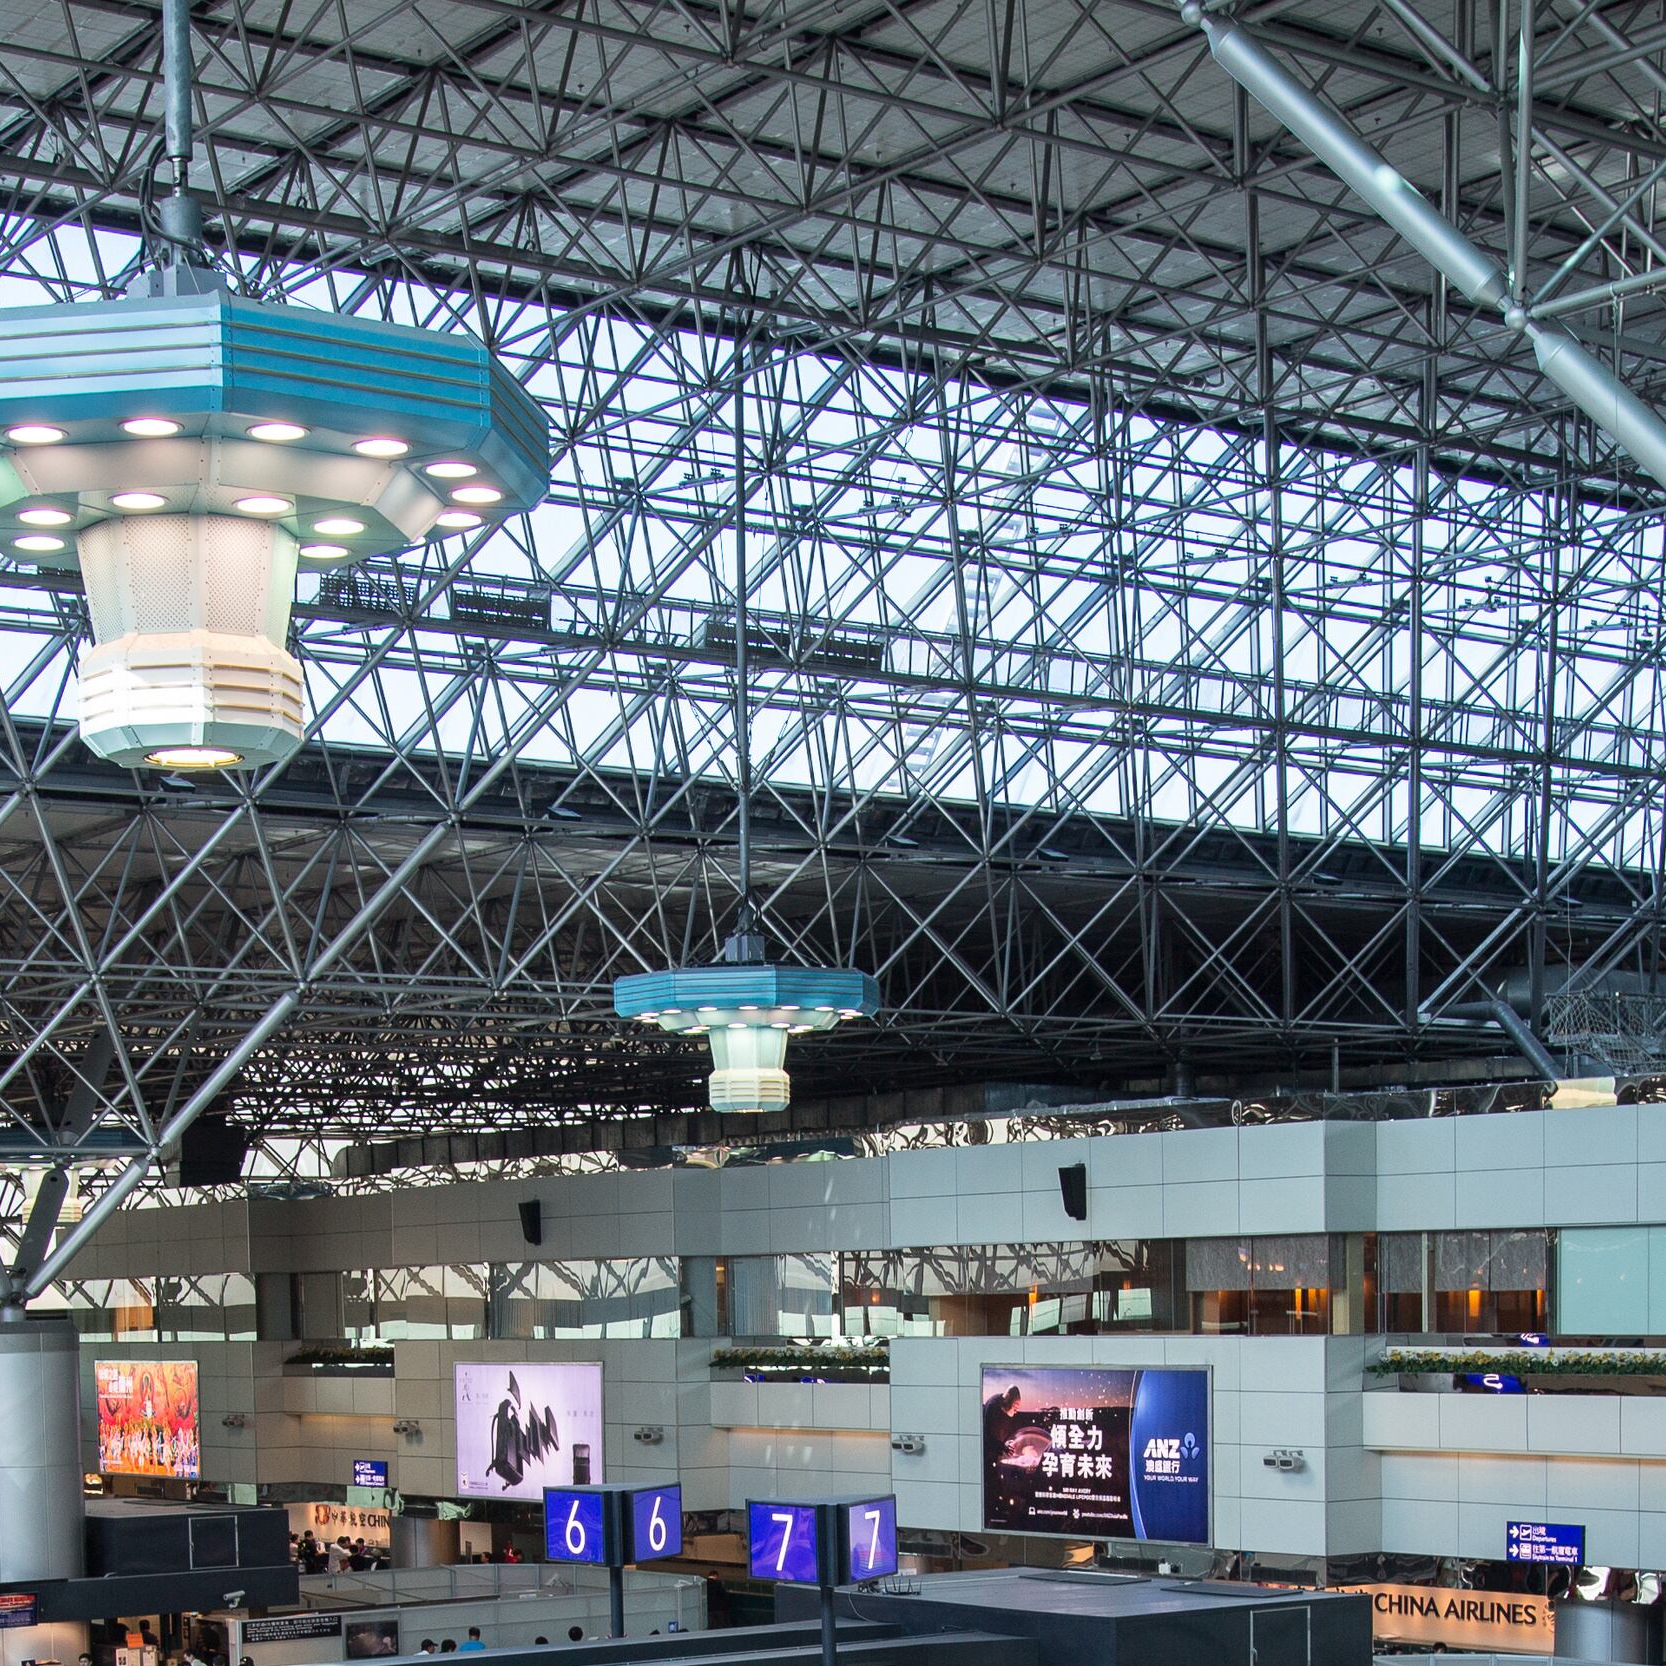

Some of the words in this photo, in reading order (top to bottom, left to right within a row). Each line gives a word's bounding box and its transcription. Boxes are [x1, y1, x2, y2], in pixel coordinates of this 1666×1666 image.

[1060, 1407, 1094, 1421] 推動創新
[1050, 1424, 1103, 1451] 傾全力
[1144, 1438, 1181, 1459] ANZ
[1042, 1452, 1113, 1480] 孕育未來
[1145, 1460, 1180, 1474] 澳盛銀行
[332, 1511, 367, 1528] 中華航空
[368, 1513, 390, 1528] CHIN
[565, 1499, 586, 1555] 6
[649, 1496, 667, 1552] 6
[1532, 1526, 1547, 1537] 出境
[771, 1513, 794, 1572] 7
[864, 1509, 881, 1571] 7
[1532, 1535, 1557, 1544] Departures
[1374, 1592, 1440, 1618] CHINA
[1444, 1597, 1537, 1626] AIRLINES
